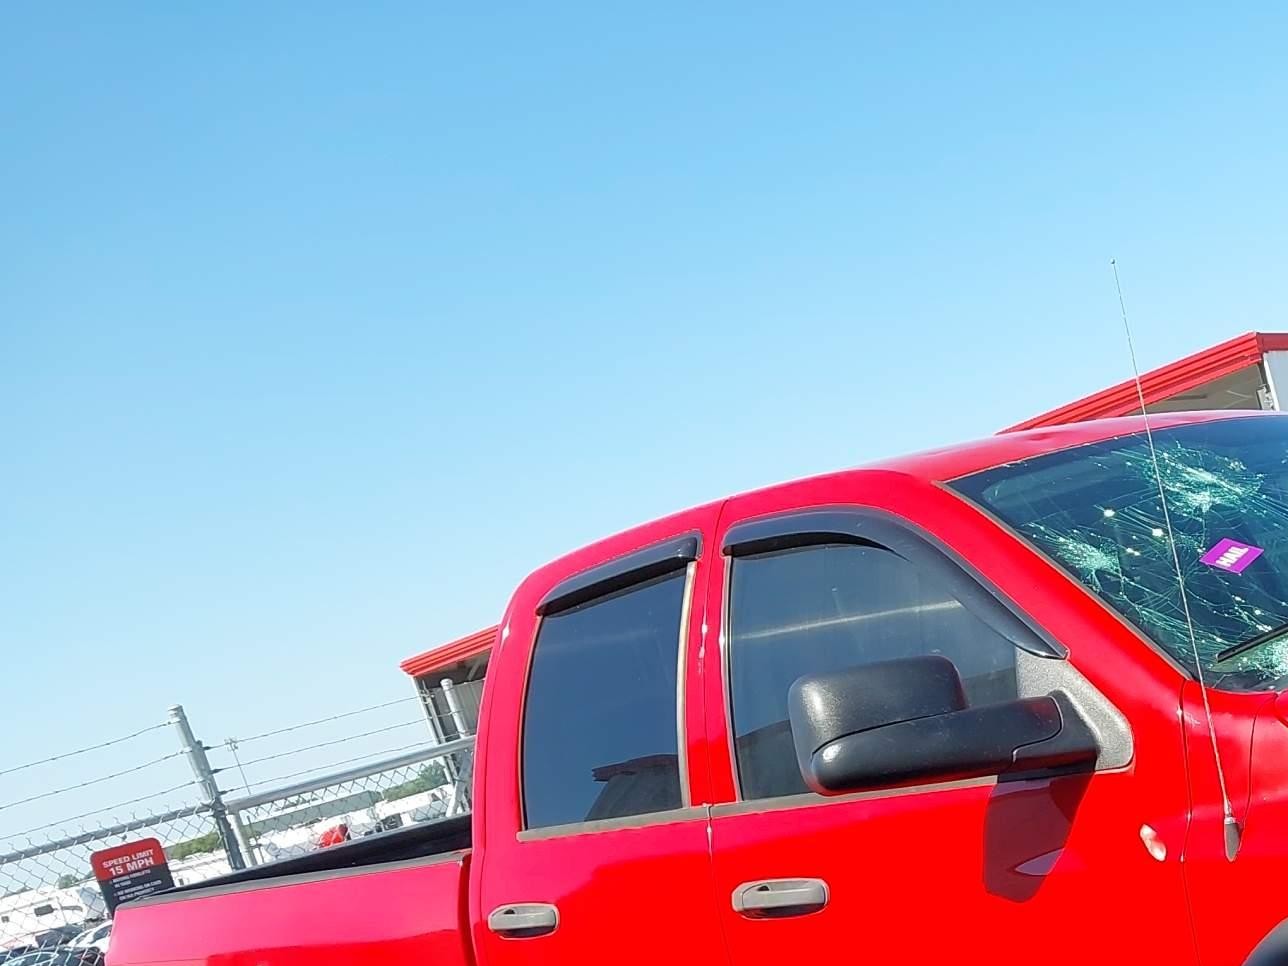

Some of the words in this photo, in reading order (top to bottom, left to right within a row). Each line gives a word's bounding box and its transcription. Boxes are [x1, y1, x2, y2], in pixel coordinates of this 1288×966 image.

[1215, 546, 1249, 568] HAIL
[102, 856, 130, 868] SPEED
[131, 849, 154, 860] LIMIT
[109, 864, 123, 876] 15
[126, 857, 154, 871] MPH
